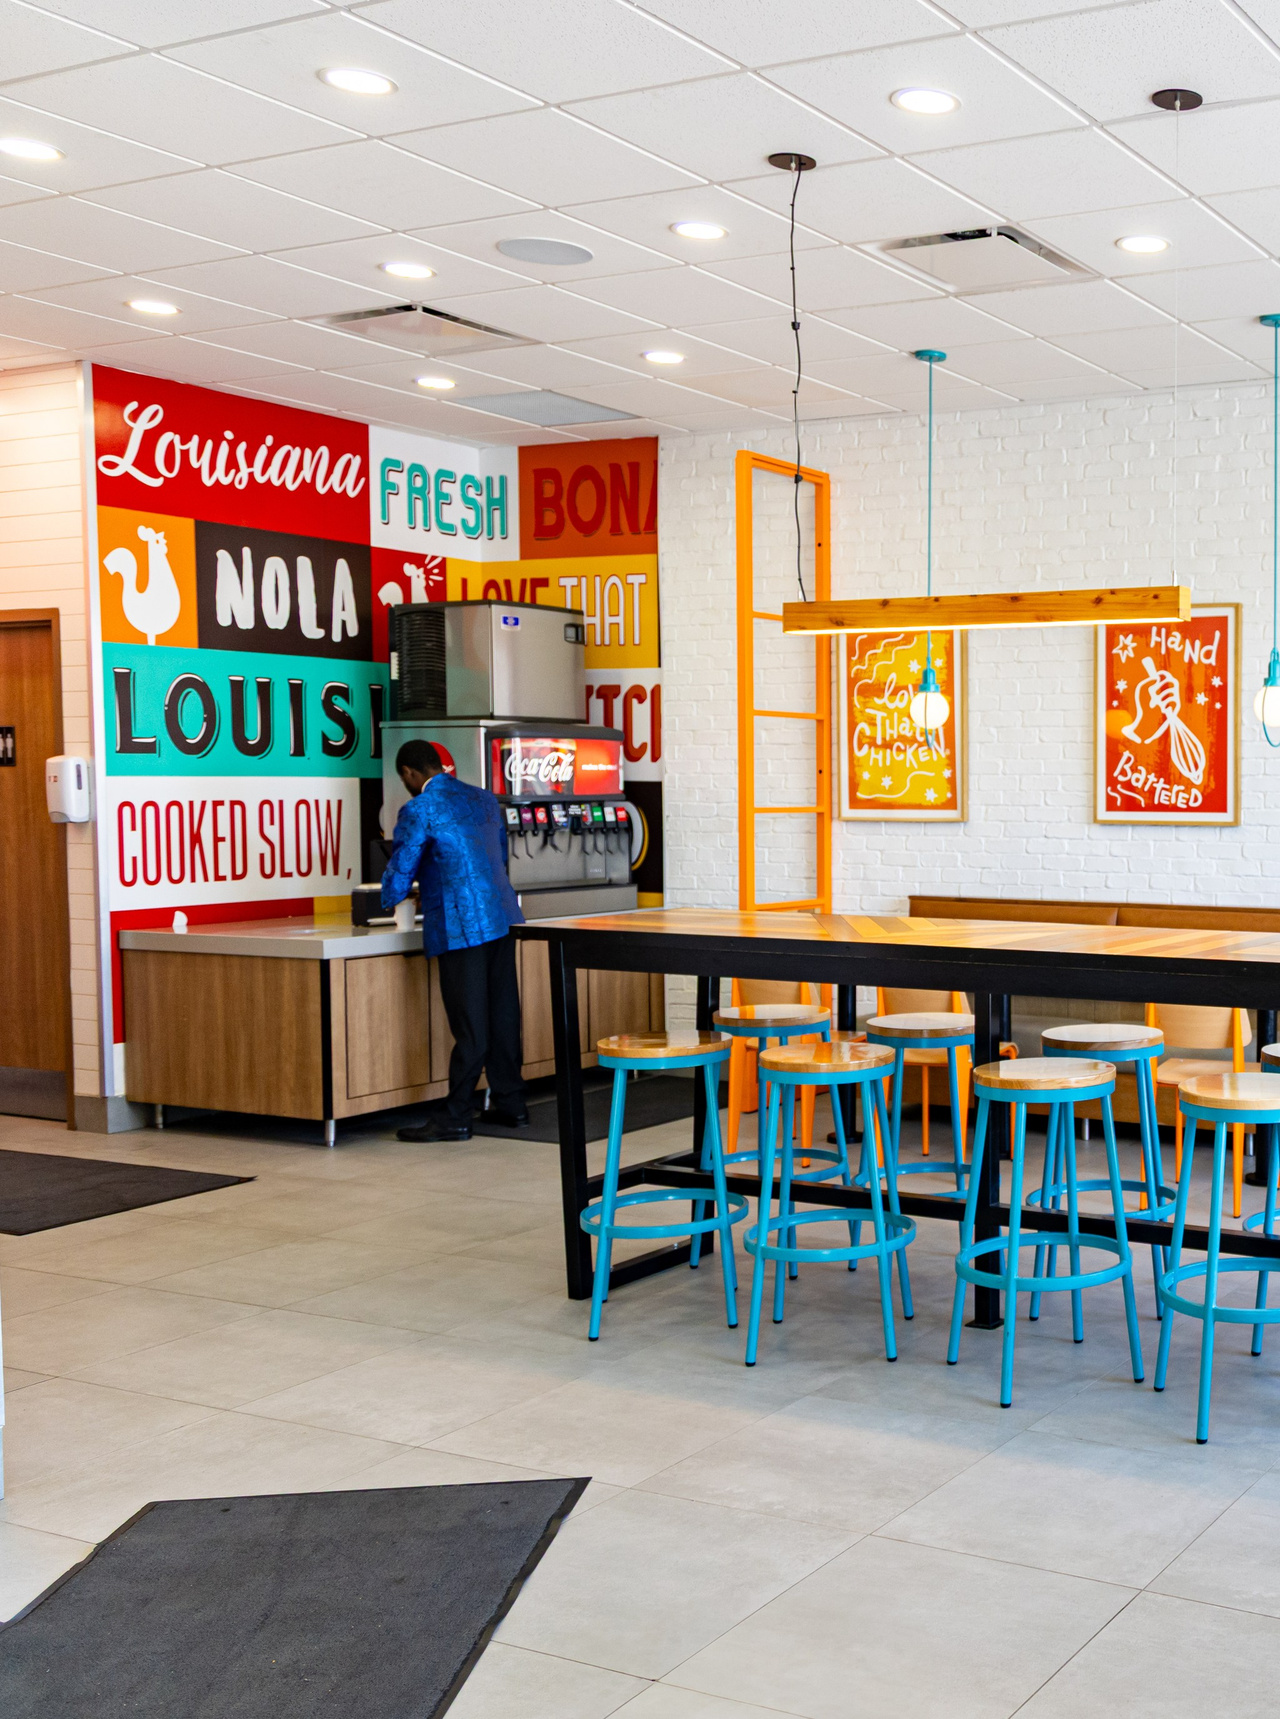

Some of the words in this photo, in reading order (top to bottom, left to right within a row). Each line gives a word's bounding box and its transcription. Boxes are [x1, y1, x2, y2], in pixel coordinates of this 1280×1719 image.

[98, 400, 366, 499] Louisiana
[380, 457, 509, 540] FRESH
[216, 546, 359, 643] NOLA
[558, 573, 647, 646] THAT
[113, 667, 383, 759] LOUISI
[504, 752, 575, 783] Coca-Cola
[117, 801, 248, 887] COOKED
[258, 799, 353, 880] SLOW,
